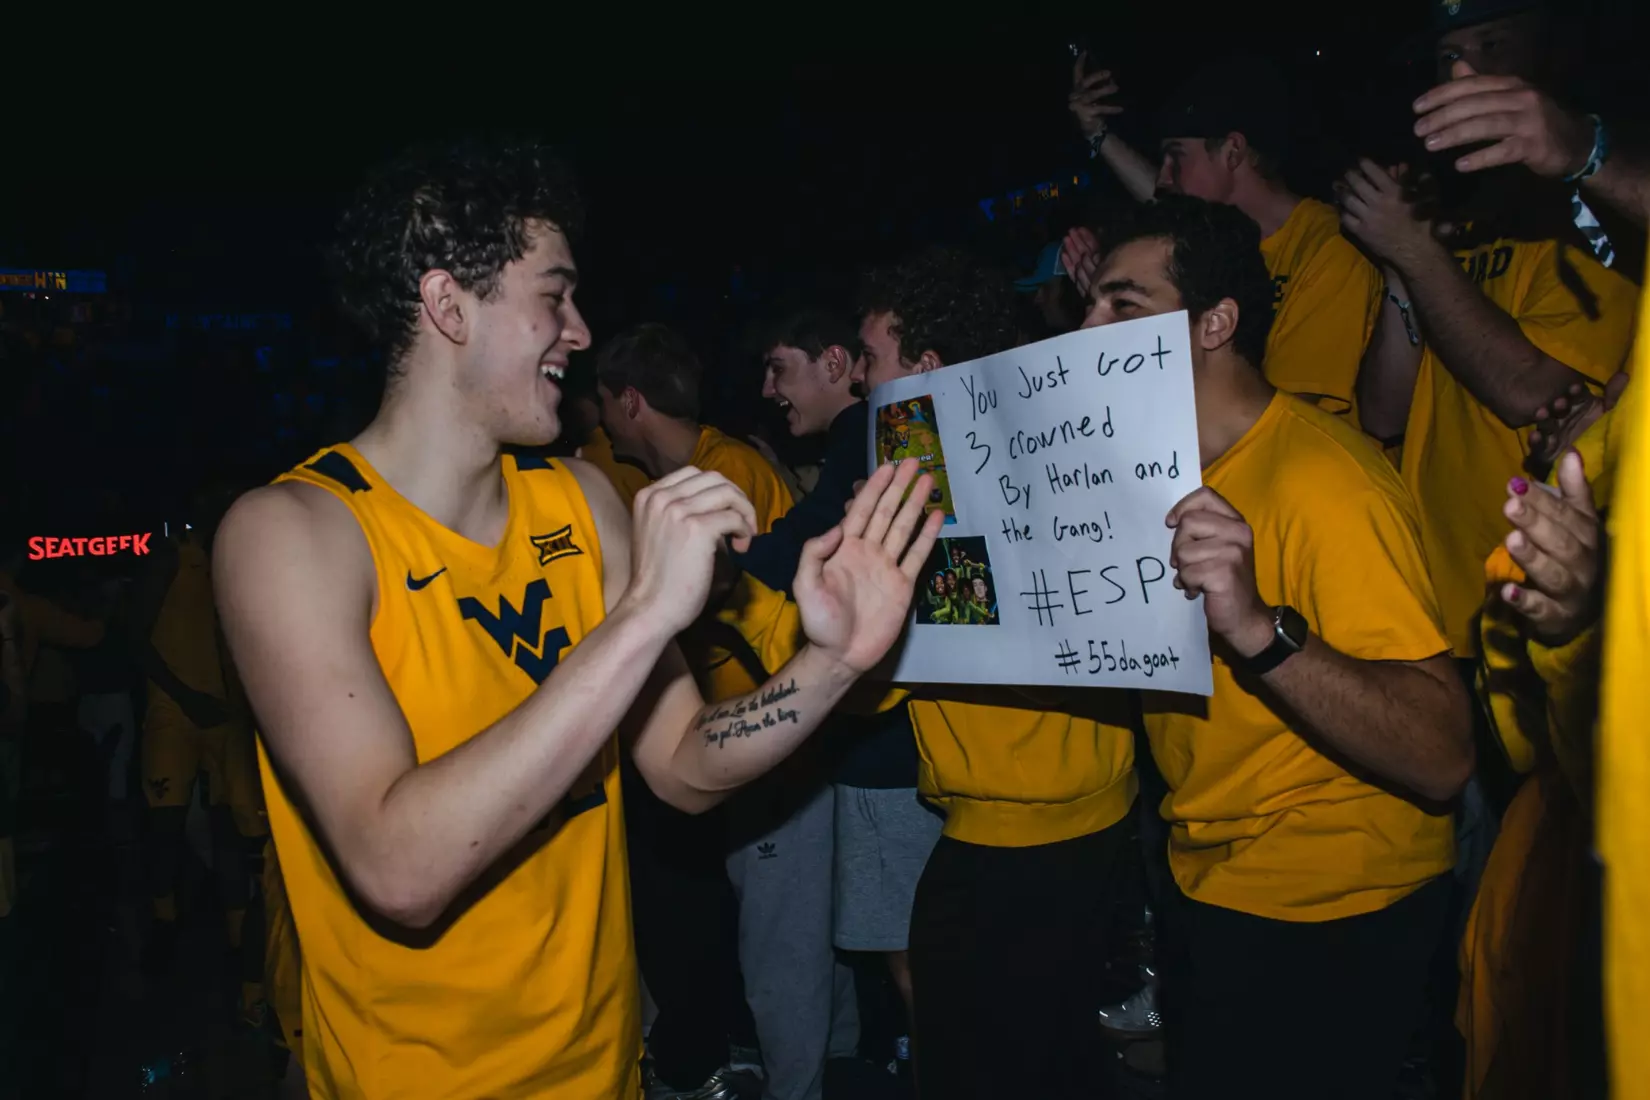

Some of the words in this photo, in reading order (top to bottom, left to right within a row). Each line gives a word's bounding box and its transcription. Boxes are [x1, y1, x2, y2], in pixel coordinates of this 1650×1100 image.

[960, 375, 998, 421] You
[1018, 355, 1069, 399] Just
[1097, 335, 1172, 376] Got
[965, 431, 991, 475] 3
[1009, 405, 1114, 460] crowned
[998, 474, 1031, 509] By
[1046, 462, 1113, 494] Harlan
[1134, 450, 1180, 481] and
[27, 532, 153, 561] SEATGEEK
[1002, 516, 1033, 544] the
[1053, 511, 1113, 543] Gang!
[1019, 555, 1166, 627] #ESP
